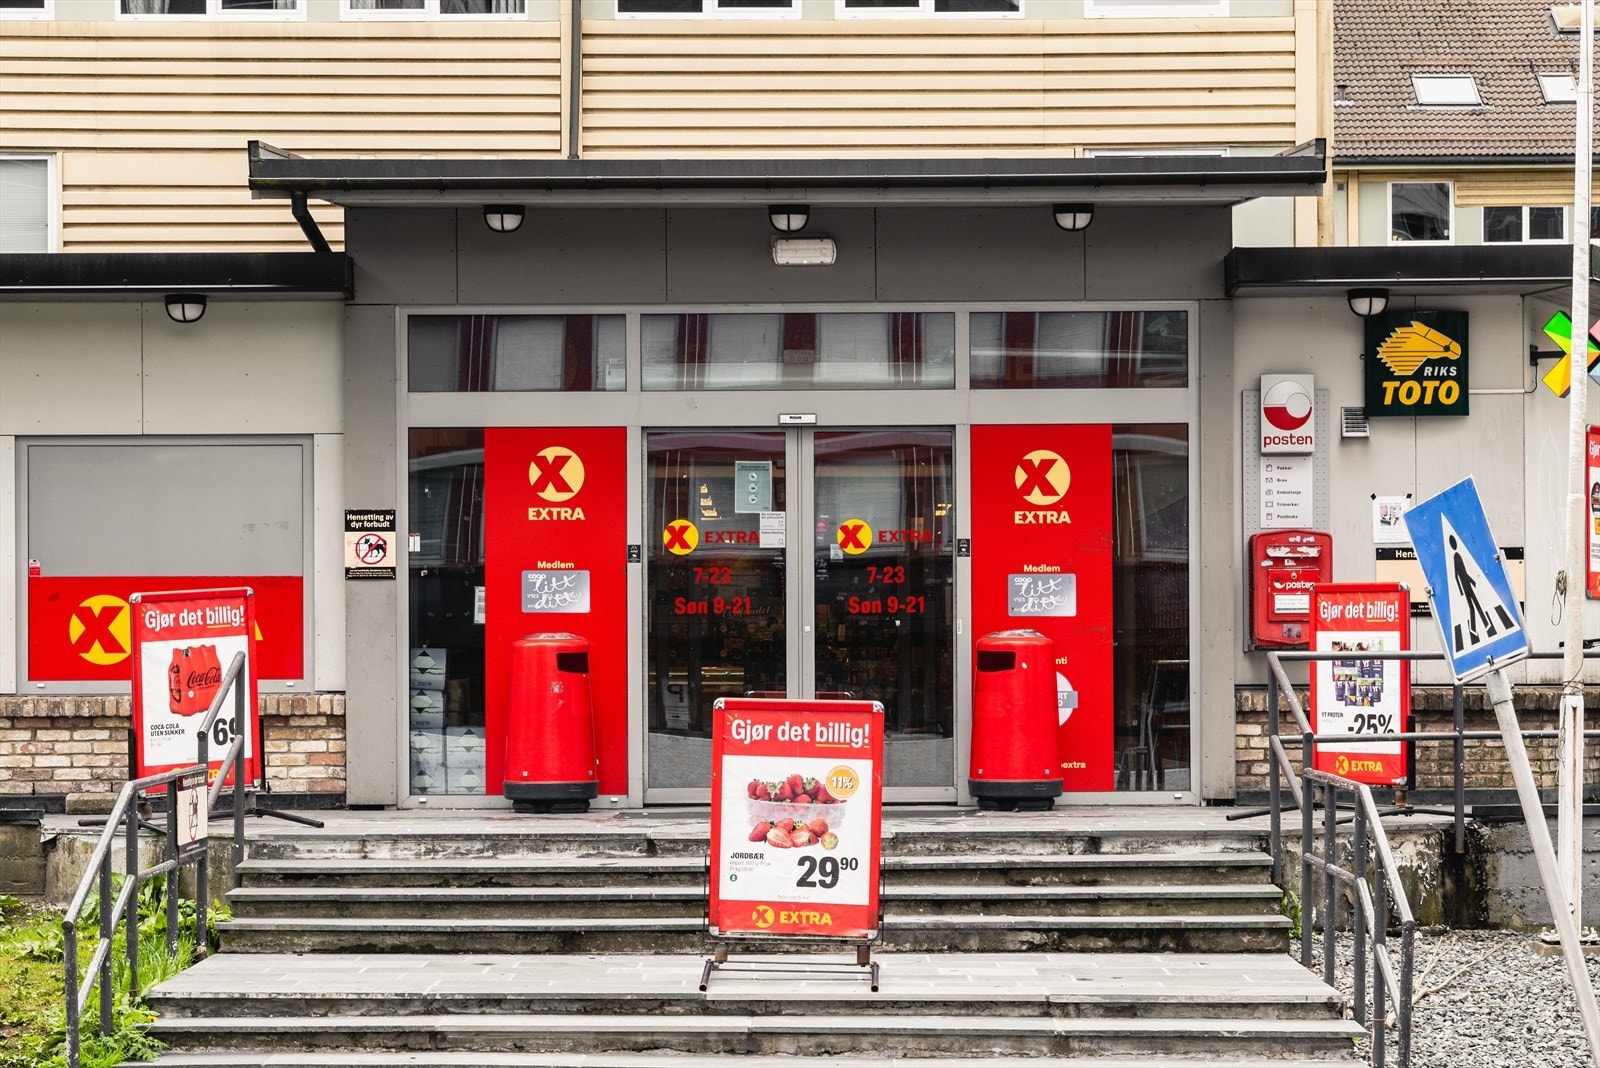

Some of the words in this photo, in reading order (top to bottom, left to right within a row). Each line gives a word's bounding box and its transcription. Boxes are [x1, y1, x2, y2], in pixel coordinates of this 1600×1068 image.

[1423, 366, 1458, 377] RIKS
[1382, 380, 1460, 405] TOTO
[1263, 433, 1313, 448] posten
[528, 507, 586, 521] EXTRA
[1014, 511, 1072, 524] EXTRA
[704, 531, 760, 543] EXTRA
[878, 530, 934, 543] EXTRA
[537, 560, 574, 568] Medlem
[1024, 564, 1060, 572] Medlem
[693, 567, 731, 584] 7-23
[866, 566, 905, 584] 7-23
[674, 596, 708, 614] Søn
[713, 596, 751, 614] 9-21
[848, 596, 882, 614] Søn
[887, 596, 925, 613] 9-21
[1320, 601, 1342, 622] Gjør
[1345, 602, 1364, 618] det
[1367, 601, 1399, 622] billig!
[145, 610, 176, 632] Gjør
[179, 608, 203, 626] det
[206, 605, 245, 627] billig!
[1348, 714, 1394, 734] -25%
[731, 719, 772, 745] Gjør
[777, 721, 810, 742] det
[815, 722, 870, 748] billig!
[1351, 760, 1383, 772] EXTRA
[832, 776, 853, 790] 11%
[796, 855, 840, 889] 29
[840, 857, 858, 870] 90
[780, 911, 832, 925] EXTRA
